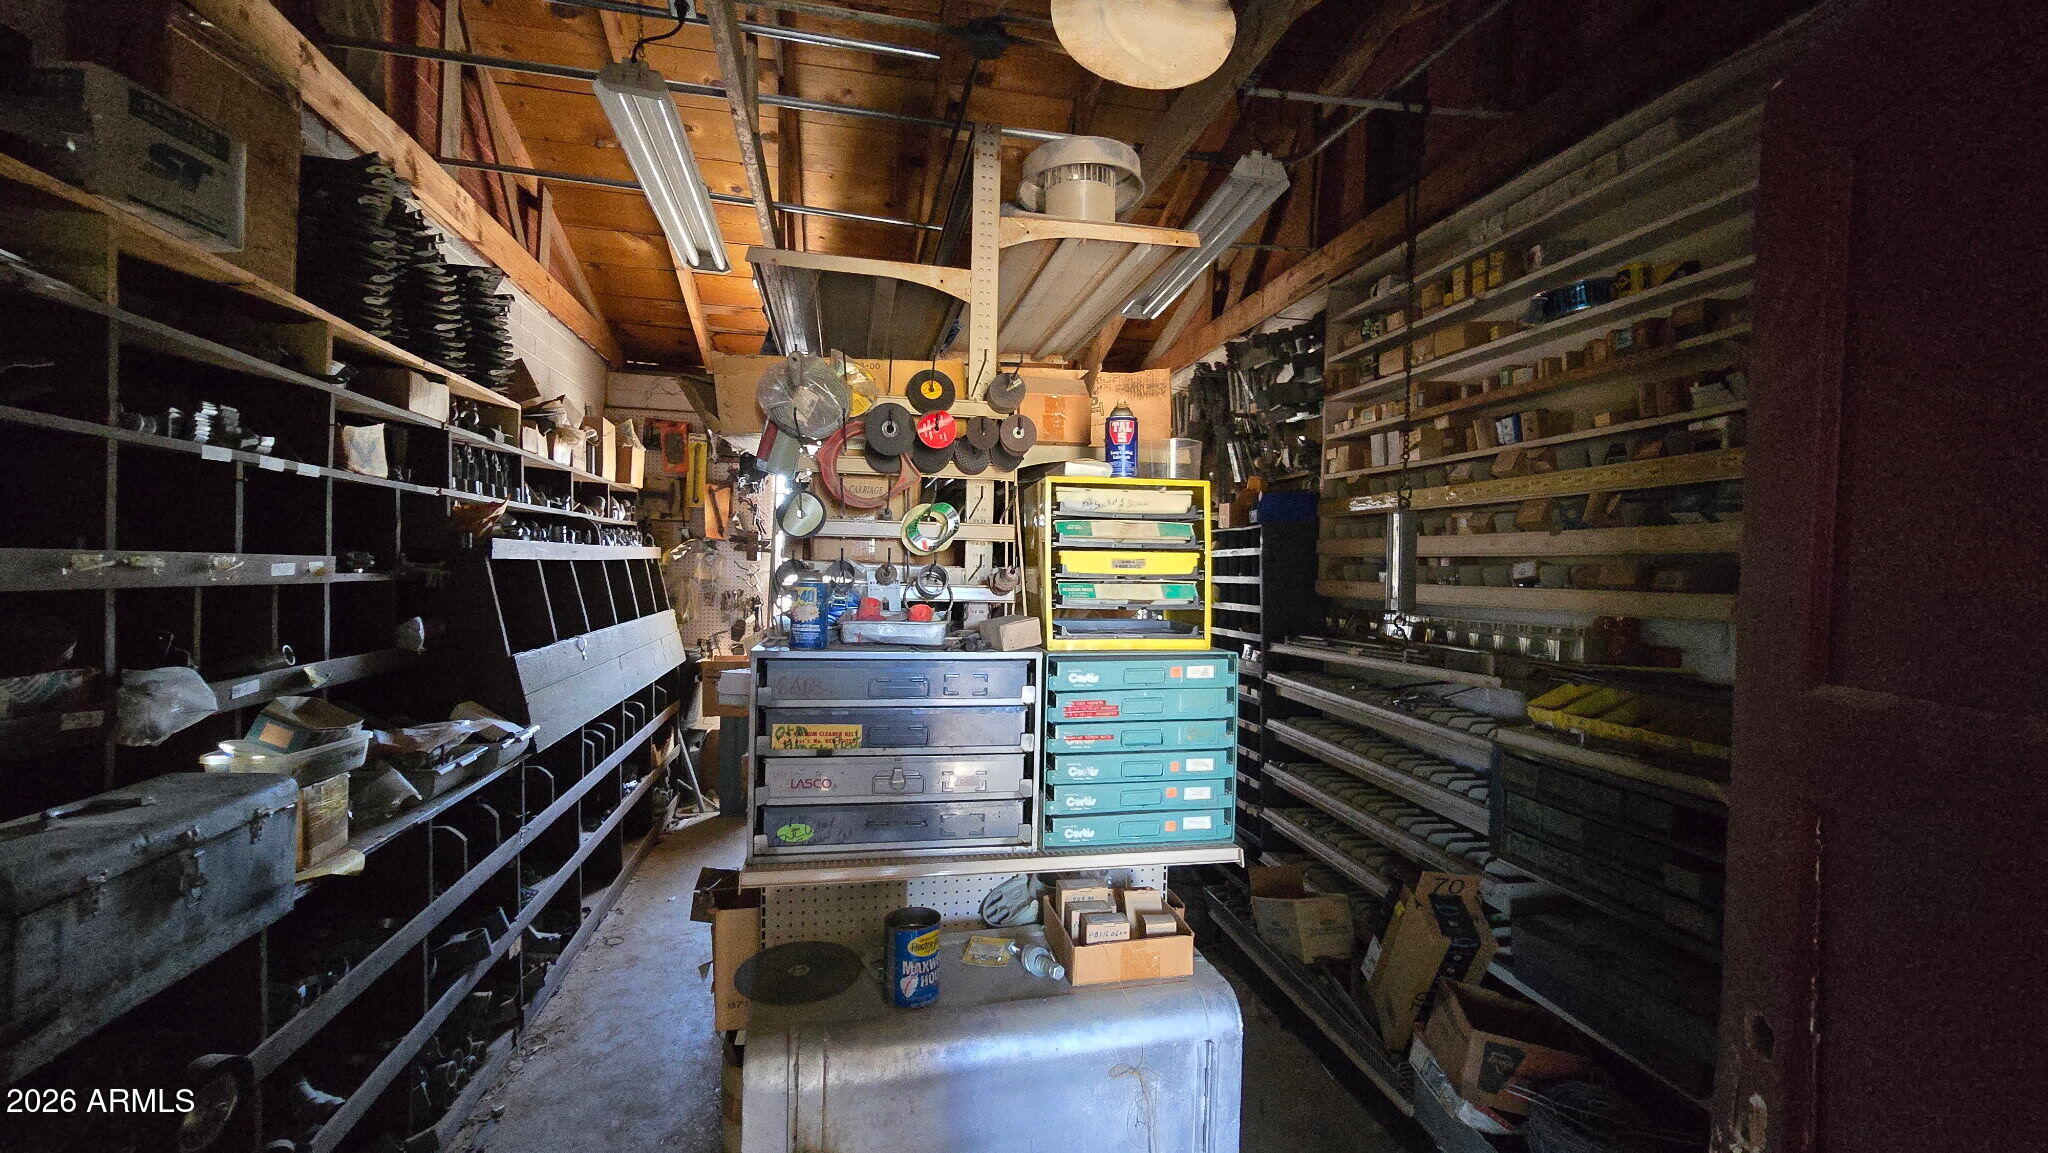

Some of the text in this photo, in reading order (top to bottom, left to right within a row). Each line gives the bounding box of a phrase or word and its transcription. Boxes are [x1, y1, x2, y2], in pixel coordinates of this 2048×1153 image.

[848, 484, 884, 495] CARRIAGE
[790, 778, 832, 789] LASCO
[1433, 877, 1465, 894] 70
